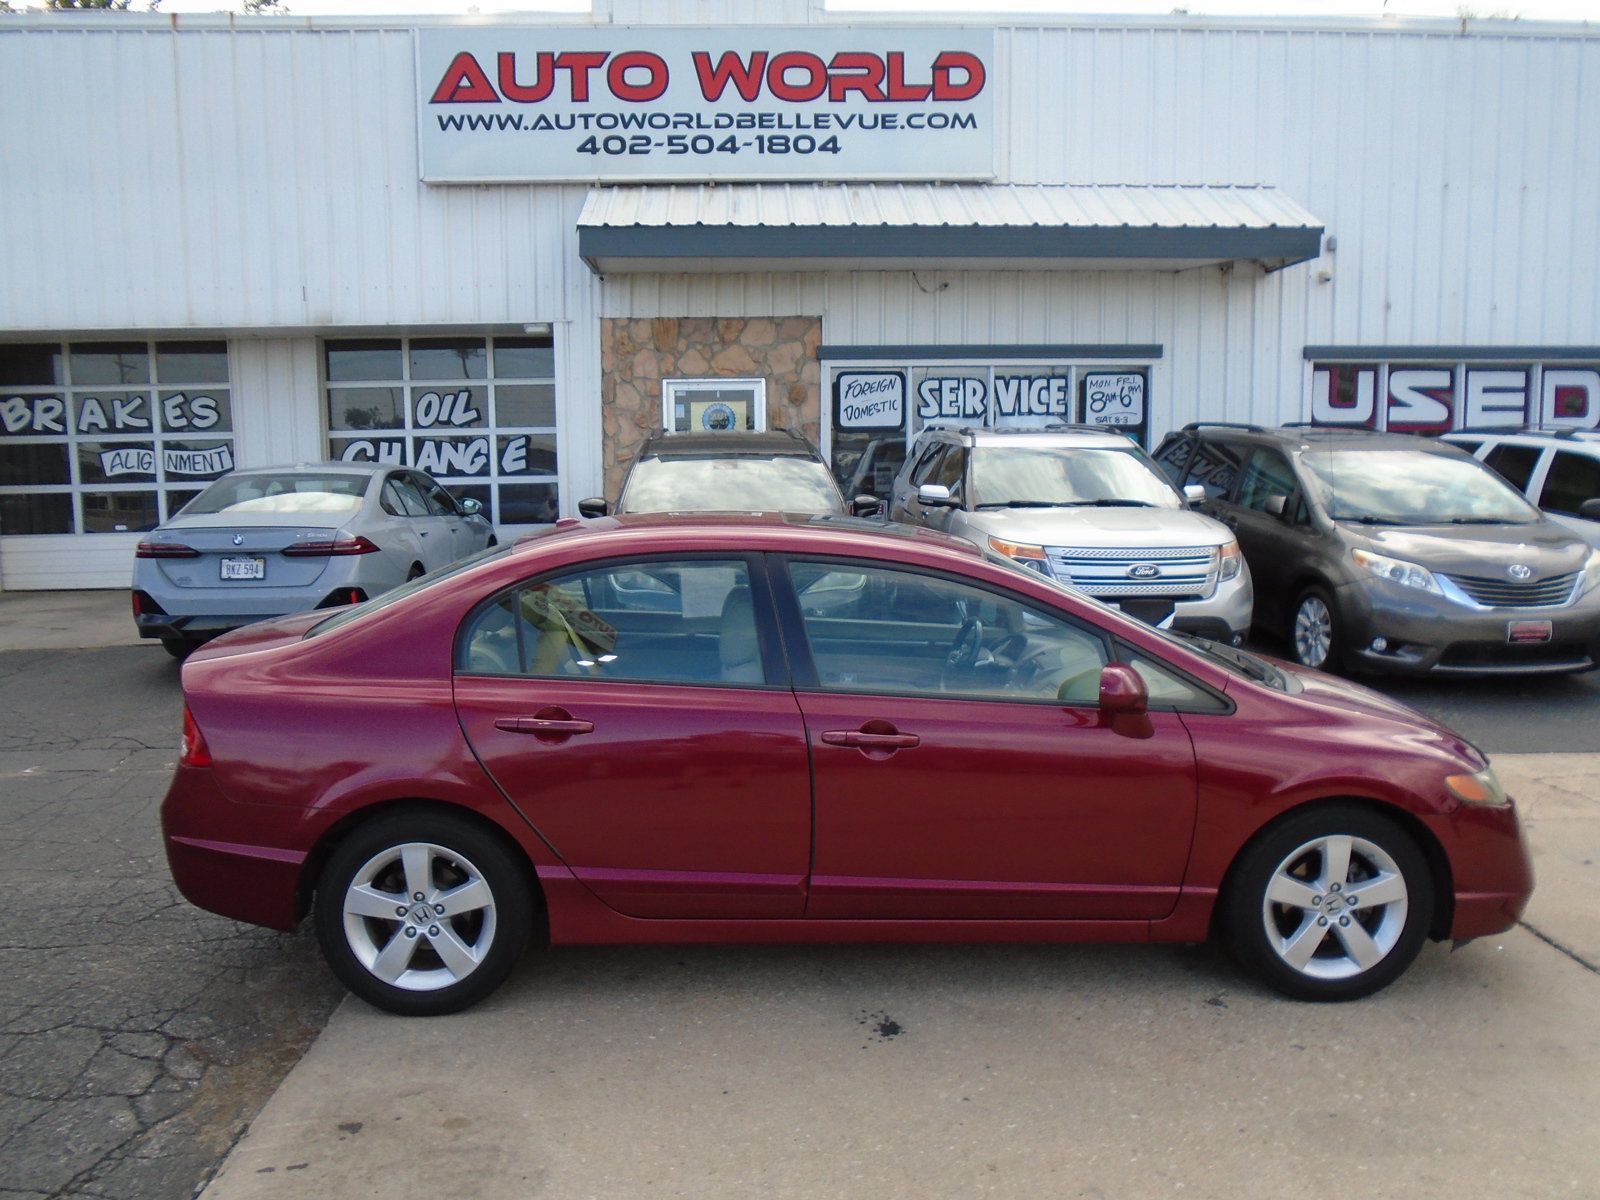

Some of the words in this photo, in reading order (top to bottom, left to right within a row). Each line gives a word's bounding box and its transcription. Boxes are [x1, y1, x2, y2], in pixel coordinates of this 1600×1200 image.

[428, 51, 669, 103] AUTO
[691, 51, 986, 102] WORLD
[437, 112, 977, 131] WWW.AUTOWORLDBELLEVUE.COM
[576, 135, 842, 154] 402-504-1804
[844, 377, 897, 399] FOREIGN
[1089, 379, 1111, 389] MON
[415, 390, 480, 428] OIL
[843, 399, 898, 421] DOMESTIC
[1312, 370, 1600, 428] USED
[0, 392, 220, 432] BRAKES
[1095, 416, 1112, 424] SAT
[341, 436, 528, 474] CHANGE
[1135, 566, 1155, 576] Ford
